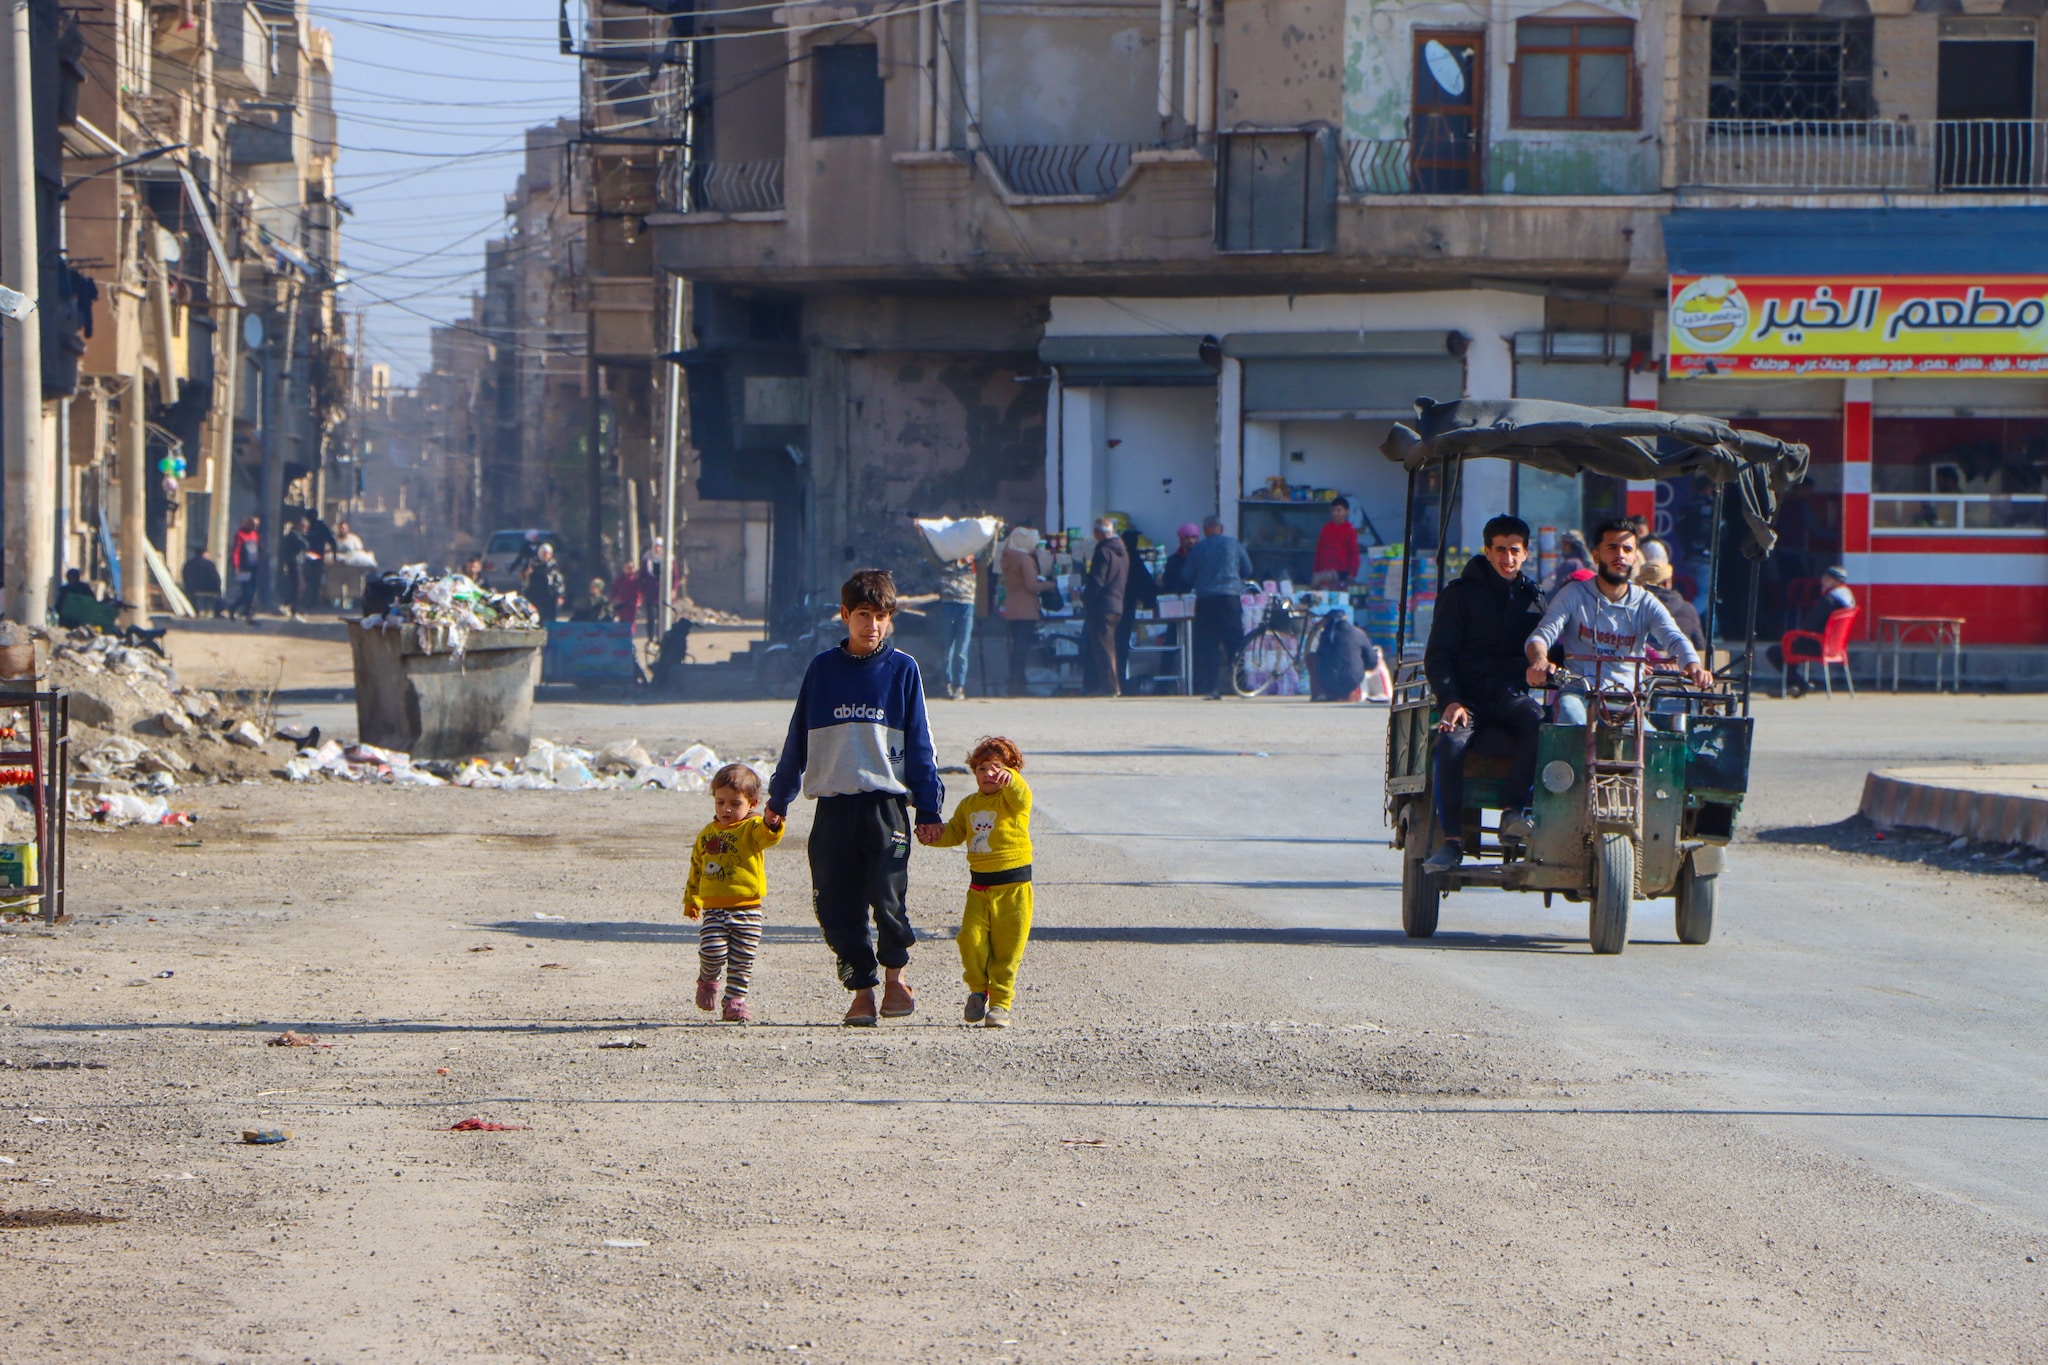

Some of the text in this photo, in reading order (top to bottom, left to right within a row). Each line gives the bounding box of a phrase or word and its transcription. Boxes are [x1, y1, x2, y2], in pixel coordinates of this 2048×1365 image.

[1752, 286, 2046, 343] مطعم الخير
[1919, 359, 1948, 372] حمص
[833, 704, 885, 720] abidas
